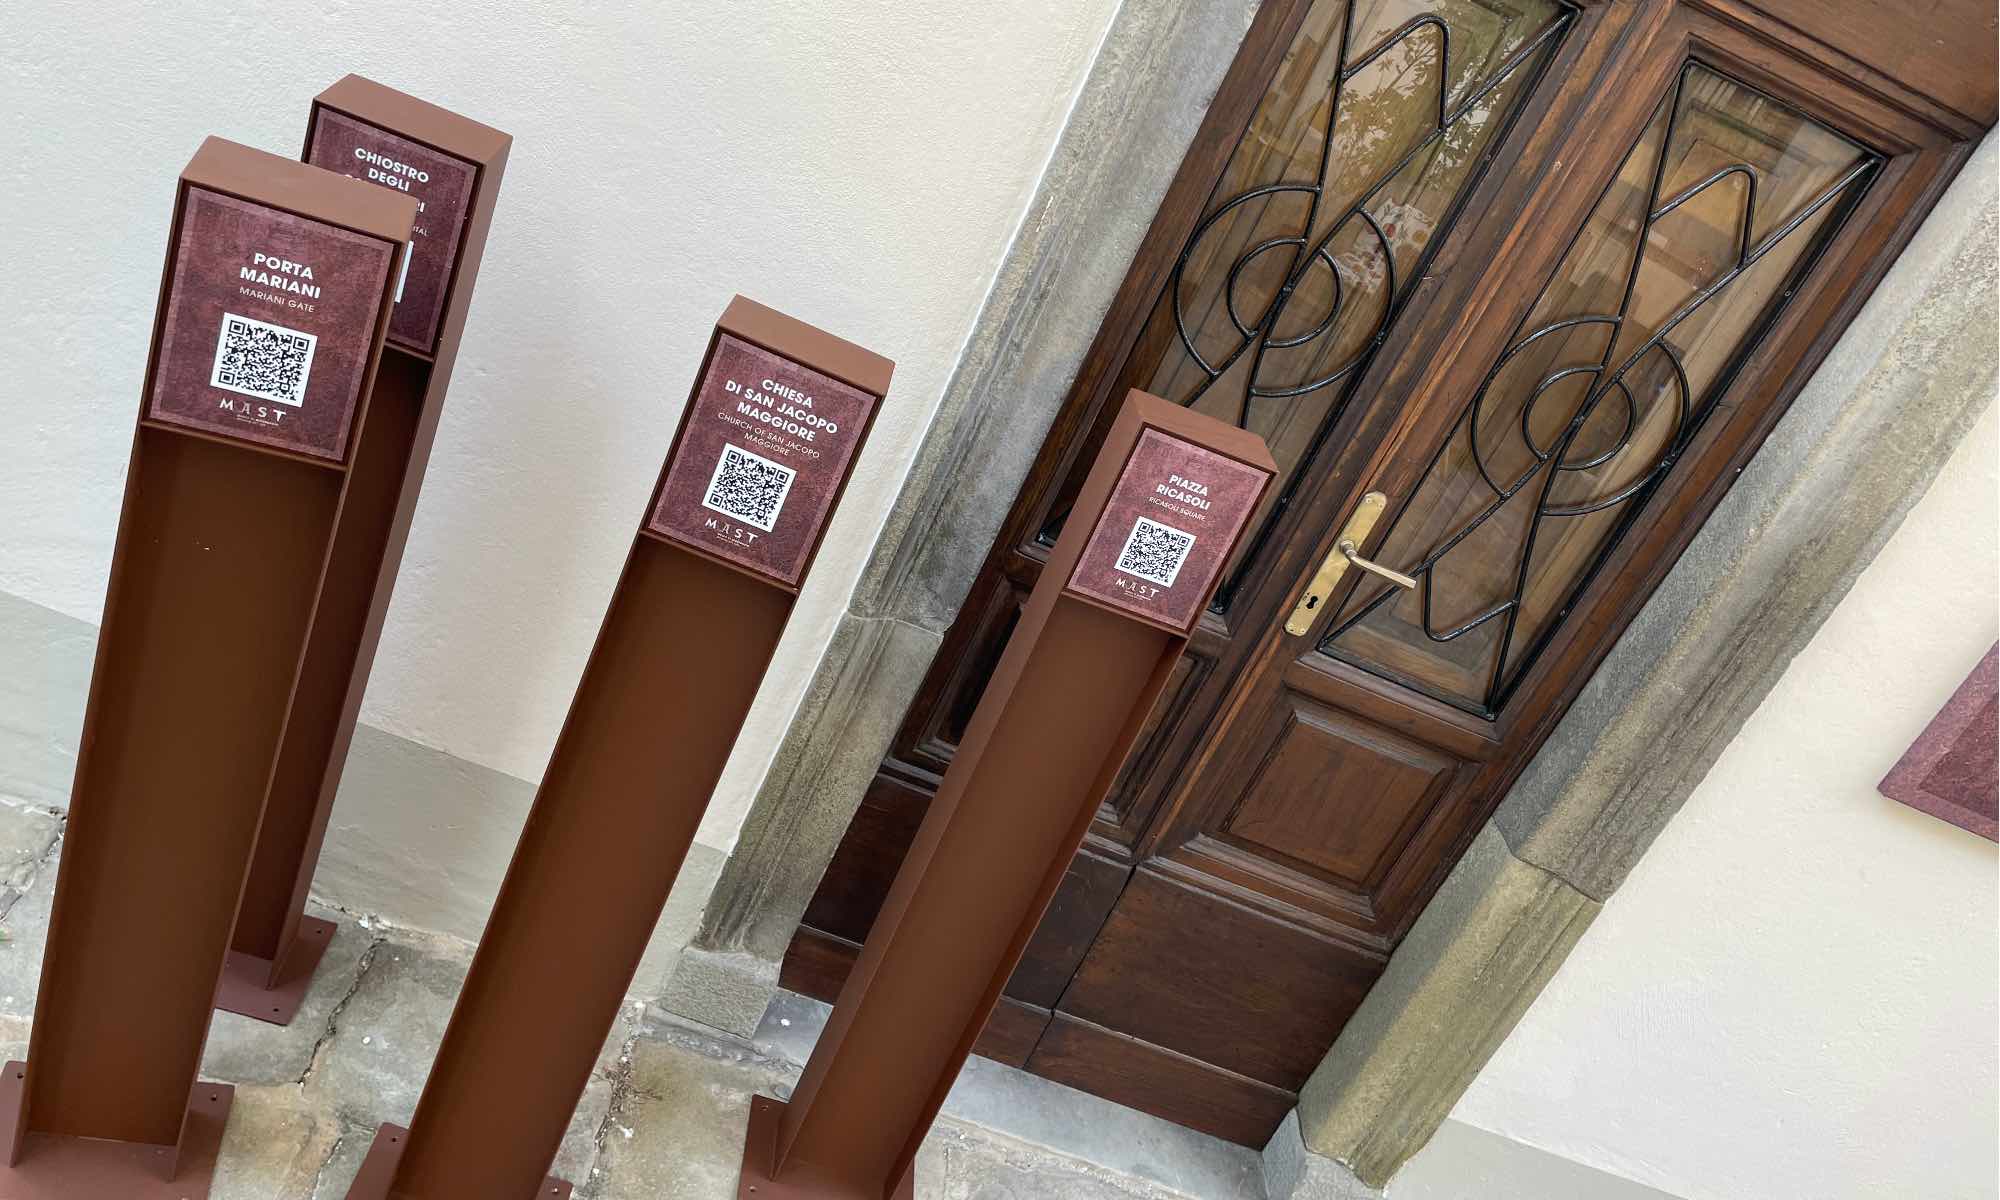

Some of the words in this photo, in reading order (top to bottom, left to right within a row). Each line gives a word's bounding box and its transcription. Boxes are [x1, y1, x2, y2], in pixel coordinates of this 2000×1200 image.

[354, 148, 430, 183] CHIOSTRO
[368, 167, 410, 192] DEGLI
[253, 252, 314, 280] PORTA
[239, 266, 321, 299] MARIANI
[238, 286, 286, 306] MARIANI
[288, 299, 316, 313] GATE
[725, 379, 743, 395] DI
[744, 387, 775, 409] SAN
[777, 402, 838, 434] JACOPO
[762, 379, 814, 409] CHIESA
[718, 412, 753, 431] CHURCH
[754, 427, 767, 438] OF
[767, 432, 785, 444] SAN
[785, 440, 820, 459] JACOPO
[737, 402, 816, 441] MAGGIORE
[743, 432, 791, 457] MAGGIORE
[1156, 484, 1211, 510] RICASOLI
[1169, 475, 1208, 496] PIAZZA
[1148, 497, 1180, 511] RICASOLI
[1180, 507, 1206, 521] SQUARE
